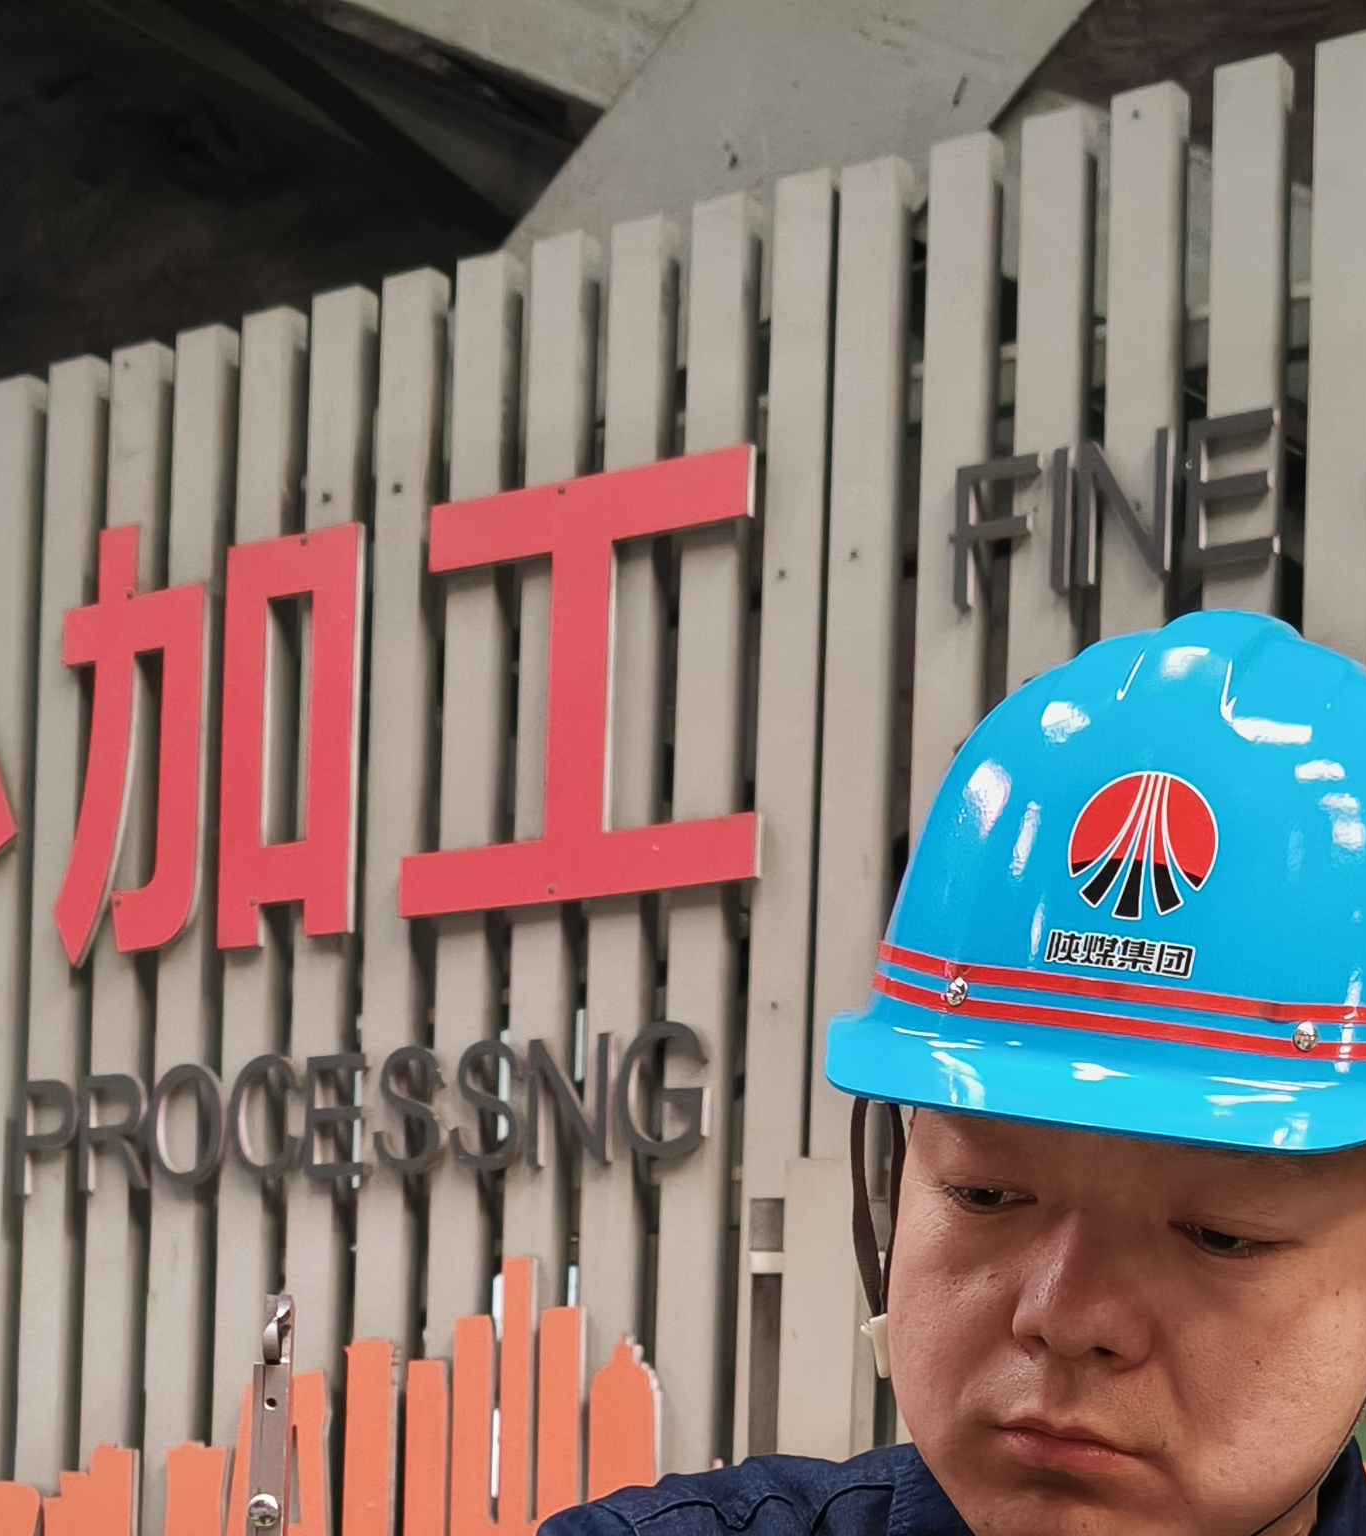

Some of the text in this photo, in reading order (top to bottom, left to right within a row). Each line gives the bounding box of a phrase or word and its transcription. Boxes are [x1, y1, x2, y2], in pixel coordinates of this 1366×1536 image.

[949, 406, 1281, 612] FINE
[1045, 929, 1196, 979] 陕煤集团
